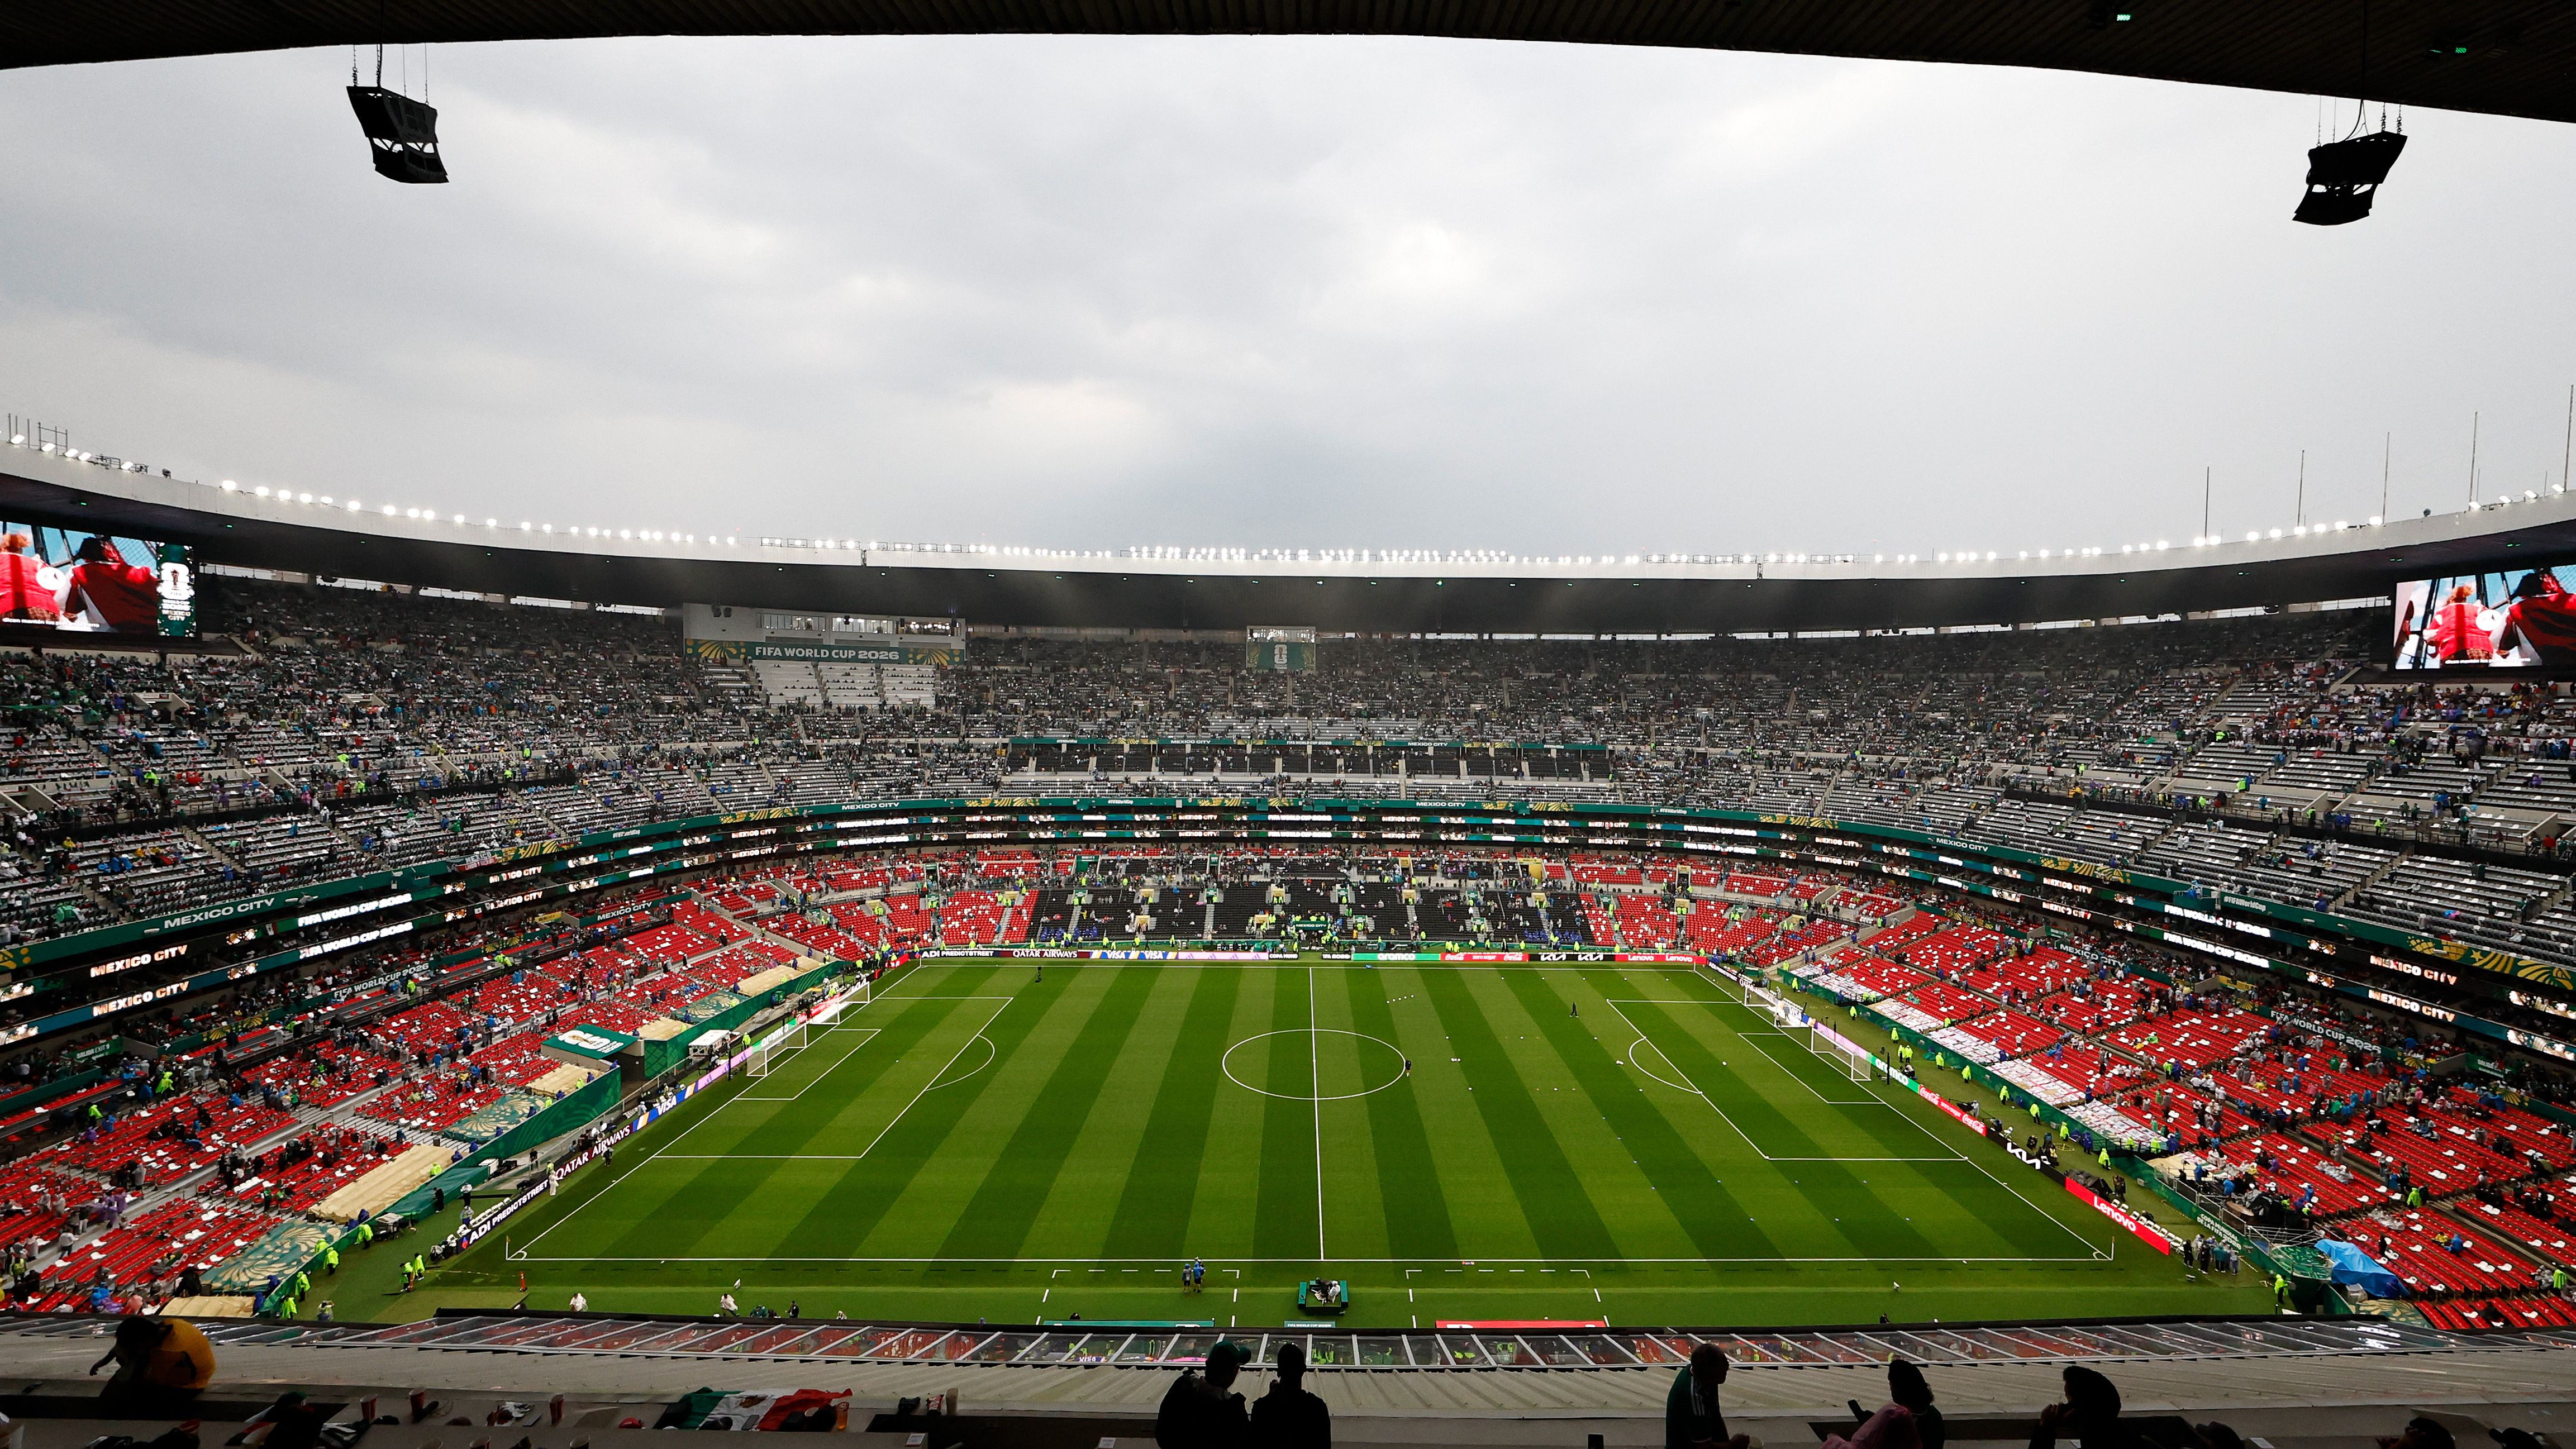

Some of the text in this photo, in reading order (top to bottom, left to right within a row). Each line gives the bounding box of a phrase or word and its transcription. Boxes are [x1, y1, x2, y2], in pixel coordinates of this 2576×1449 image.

[755, 646, 899, 660] FIFA WORLD CUP 2026
[732, 830, 759, 838] MEXICO
[1815, 837, 1842, 846] MEXICO
[732, 849, 760, 859] MEXICO
[1936, 837, 1988, 852] MEXICO CITY
[465, 852, 492, 864] MEXICO
[1815, 855, 1859, 867] MEXICO CITY
[523, 866, 542, 876] CITY
[2043, 877, 2093, 894] MEXICO CITY
[524, 892, 542, 902] CITY
[2223, 895, 2266, 912] #FIFAWorldCup
[164, 898, 275, 929] MEXICO CITY
[298, 893, 412, 927] FIFA WORLD CUP 2026
[597, 902, 653, 921] MEXICO CITY
[2164, 904, 2184, 914] FIFA
[323, 933, 362, 953] WORLD
[362, 930, 380, 942] CUP
[2163, 932, 2183, 944] FIFA
[2183, 937, 2215, 953] WORLD
[2215, 946, 2234, 957] CUP
[1013, 950, 1040, 958] QATAR
[1107, 951, 1163, 960] VISA VISA
[2060, 943, 2099, 960] MEXICO
[91, 945, 188, 978] MEXICO CITY
[334, 962, 430, 999] FIFA WORLD CUP 2026
[2424, 970, 2457, 985] CITY
[92, 981, 189, 1017] MEXICO CITY
[2369, 989, 2455, 1022] MEXICO CITY
[1789, 1007, 1802, 1019] VISA
[2293, 1018, 2324, 1034] WORLD
[2325, 1029, 2345, 1041] CUP
[657, 1096, 677, 1116] VISA
[1919, 1087, 1939, 1105] Coca-Cola
[1962, 1114, 1984, 1134] Coca-Cola
[555, 1125, 631, 1181] QATAR AIRWAYS
[2007, 1142, 2041, 1170] KIA
[469, 1179, 549, 1245] ADI PREDICTSTREET
[2093, 1196, 2137, 1233] Lenovo
[2197, 1216, 2204, 1226] DE
[2203, 1221, 2211, 1230] LA
[2211, 1226, 2223, 1238] FIFA
[2201, 1213, 2239, 1242] COPA MUNDIAL
